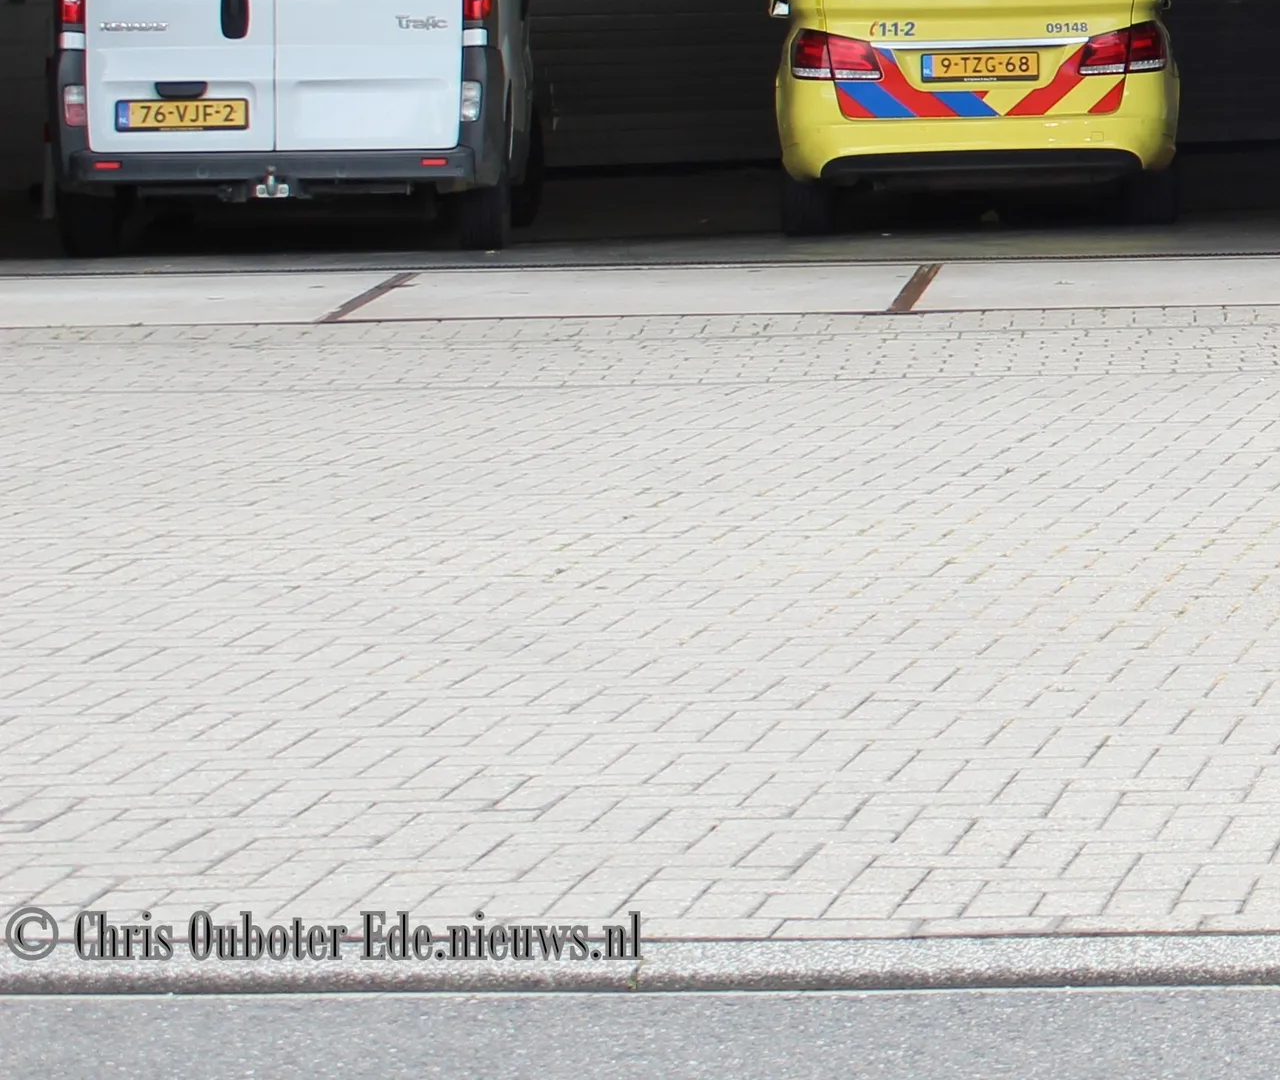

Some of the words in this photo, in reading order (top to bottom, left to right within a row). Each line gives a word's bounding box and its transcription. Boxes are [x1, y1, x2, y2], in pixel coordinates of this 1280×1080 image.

[395, 14, 449, 31] Trafic
[879, 22, 915, 37] 1-1-2
[1046, 22, 1089, 34] 09148
[941, 56, 1030, 74] 9-TZG-68
[140, 104, 236, 123] 76-VJF-2
